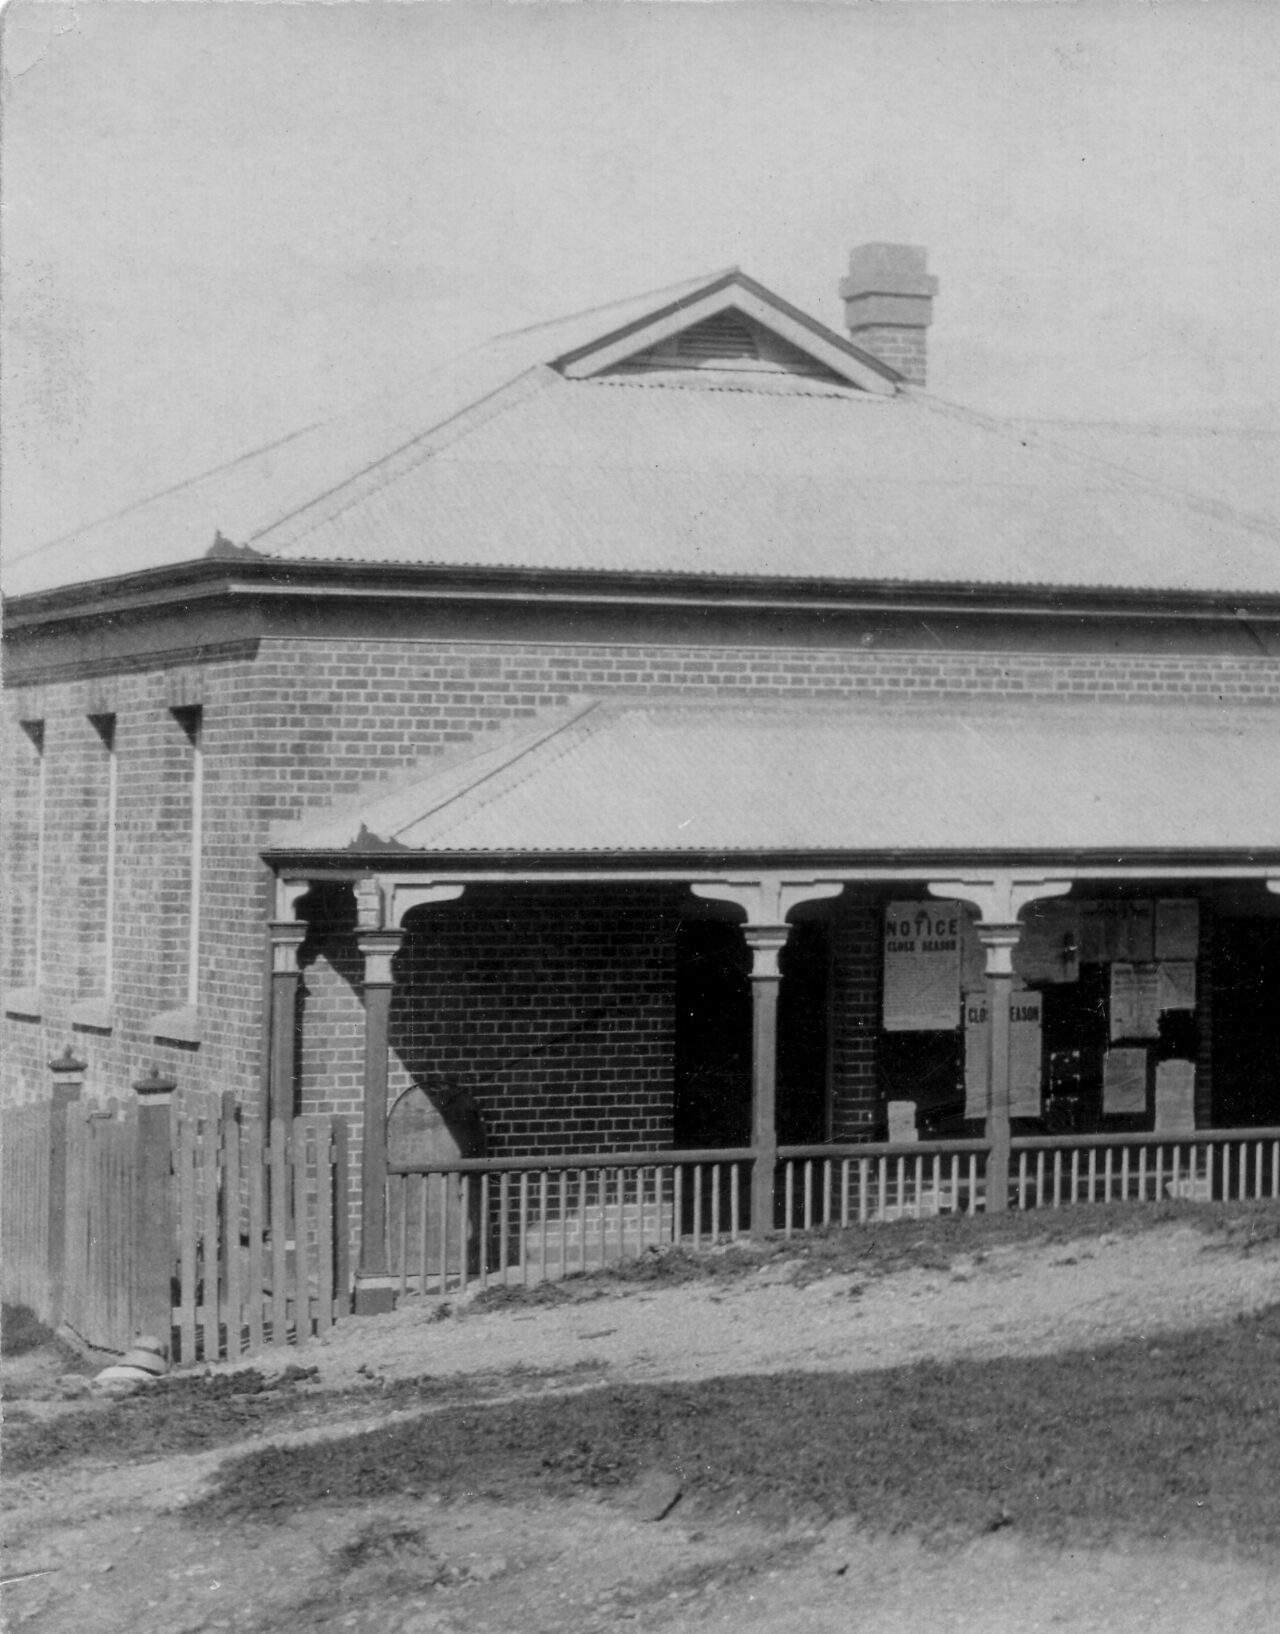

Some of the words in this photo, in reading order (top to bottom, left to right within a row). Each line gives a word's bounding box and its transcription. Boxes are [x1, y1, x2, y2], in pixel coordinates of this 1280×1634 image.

[886, 919, 958, 936] NOTICE
[887, 940, 915, 953] CLOSE
[921, 940, 957, 952] SEASON
[968, 1007, 994, 1023] CLO
[1009, 1005, 1039, 1023] EASON
